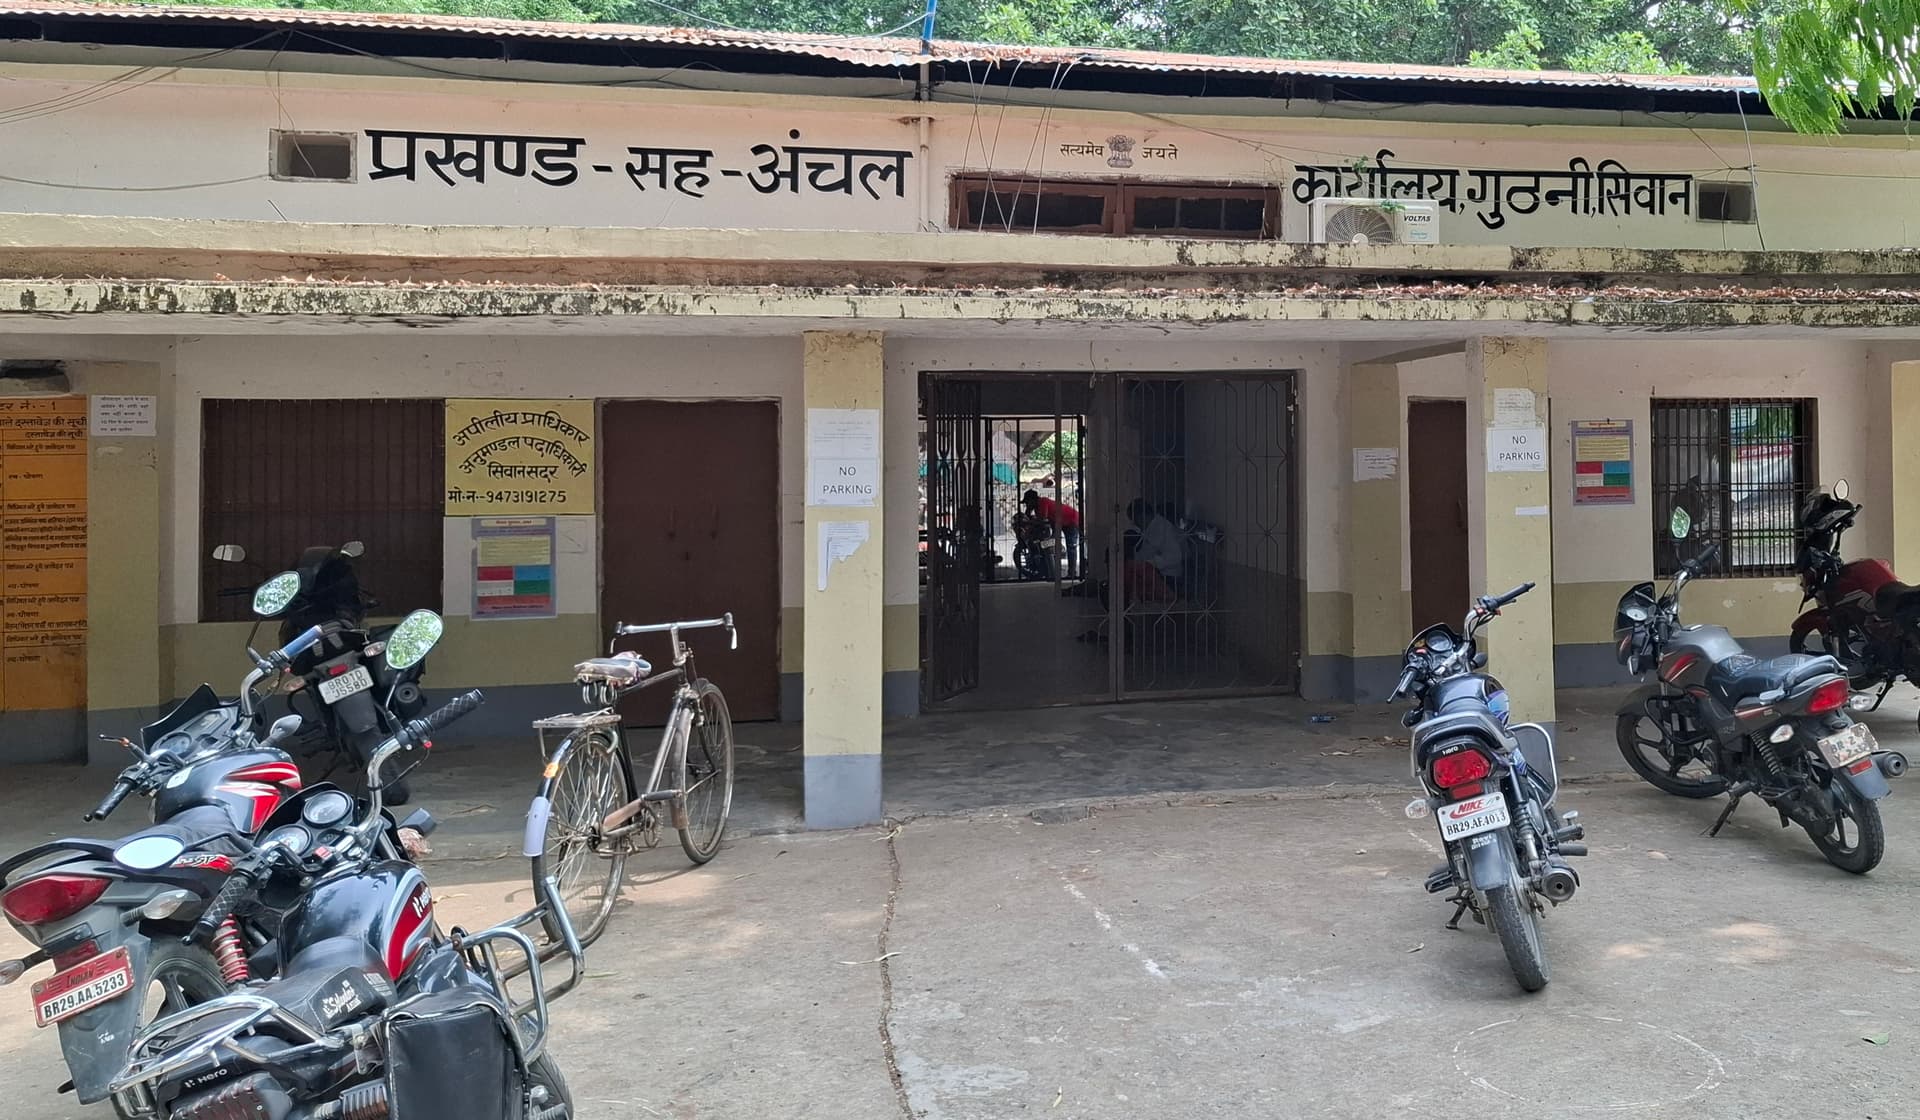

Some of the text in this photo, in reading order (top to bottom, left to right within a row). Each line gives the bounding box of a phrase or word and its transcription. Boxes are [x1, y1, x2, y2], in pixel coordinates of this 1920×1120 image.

[1060, 141, 1178, 159] सत्यमेव जयते
[452, 410, 590, 447] अपीलीय प्राधिकार
[1512, 436, 1527, 445] NO
[458, 436, 587, 478] अनुमण्डल पदाधिकारी
[1499, 451, 1540, 461] PARKING
[488, 461, 560, 483] सिवान सदर
[839, 466, 857, 477] NO
[823, 484, 872, 495] PARKING
[1458, 799, 1485, 814] NIKE
[44, 973, 125, 1018] BR29.AA.5233
